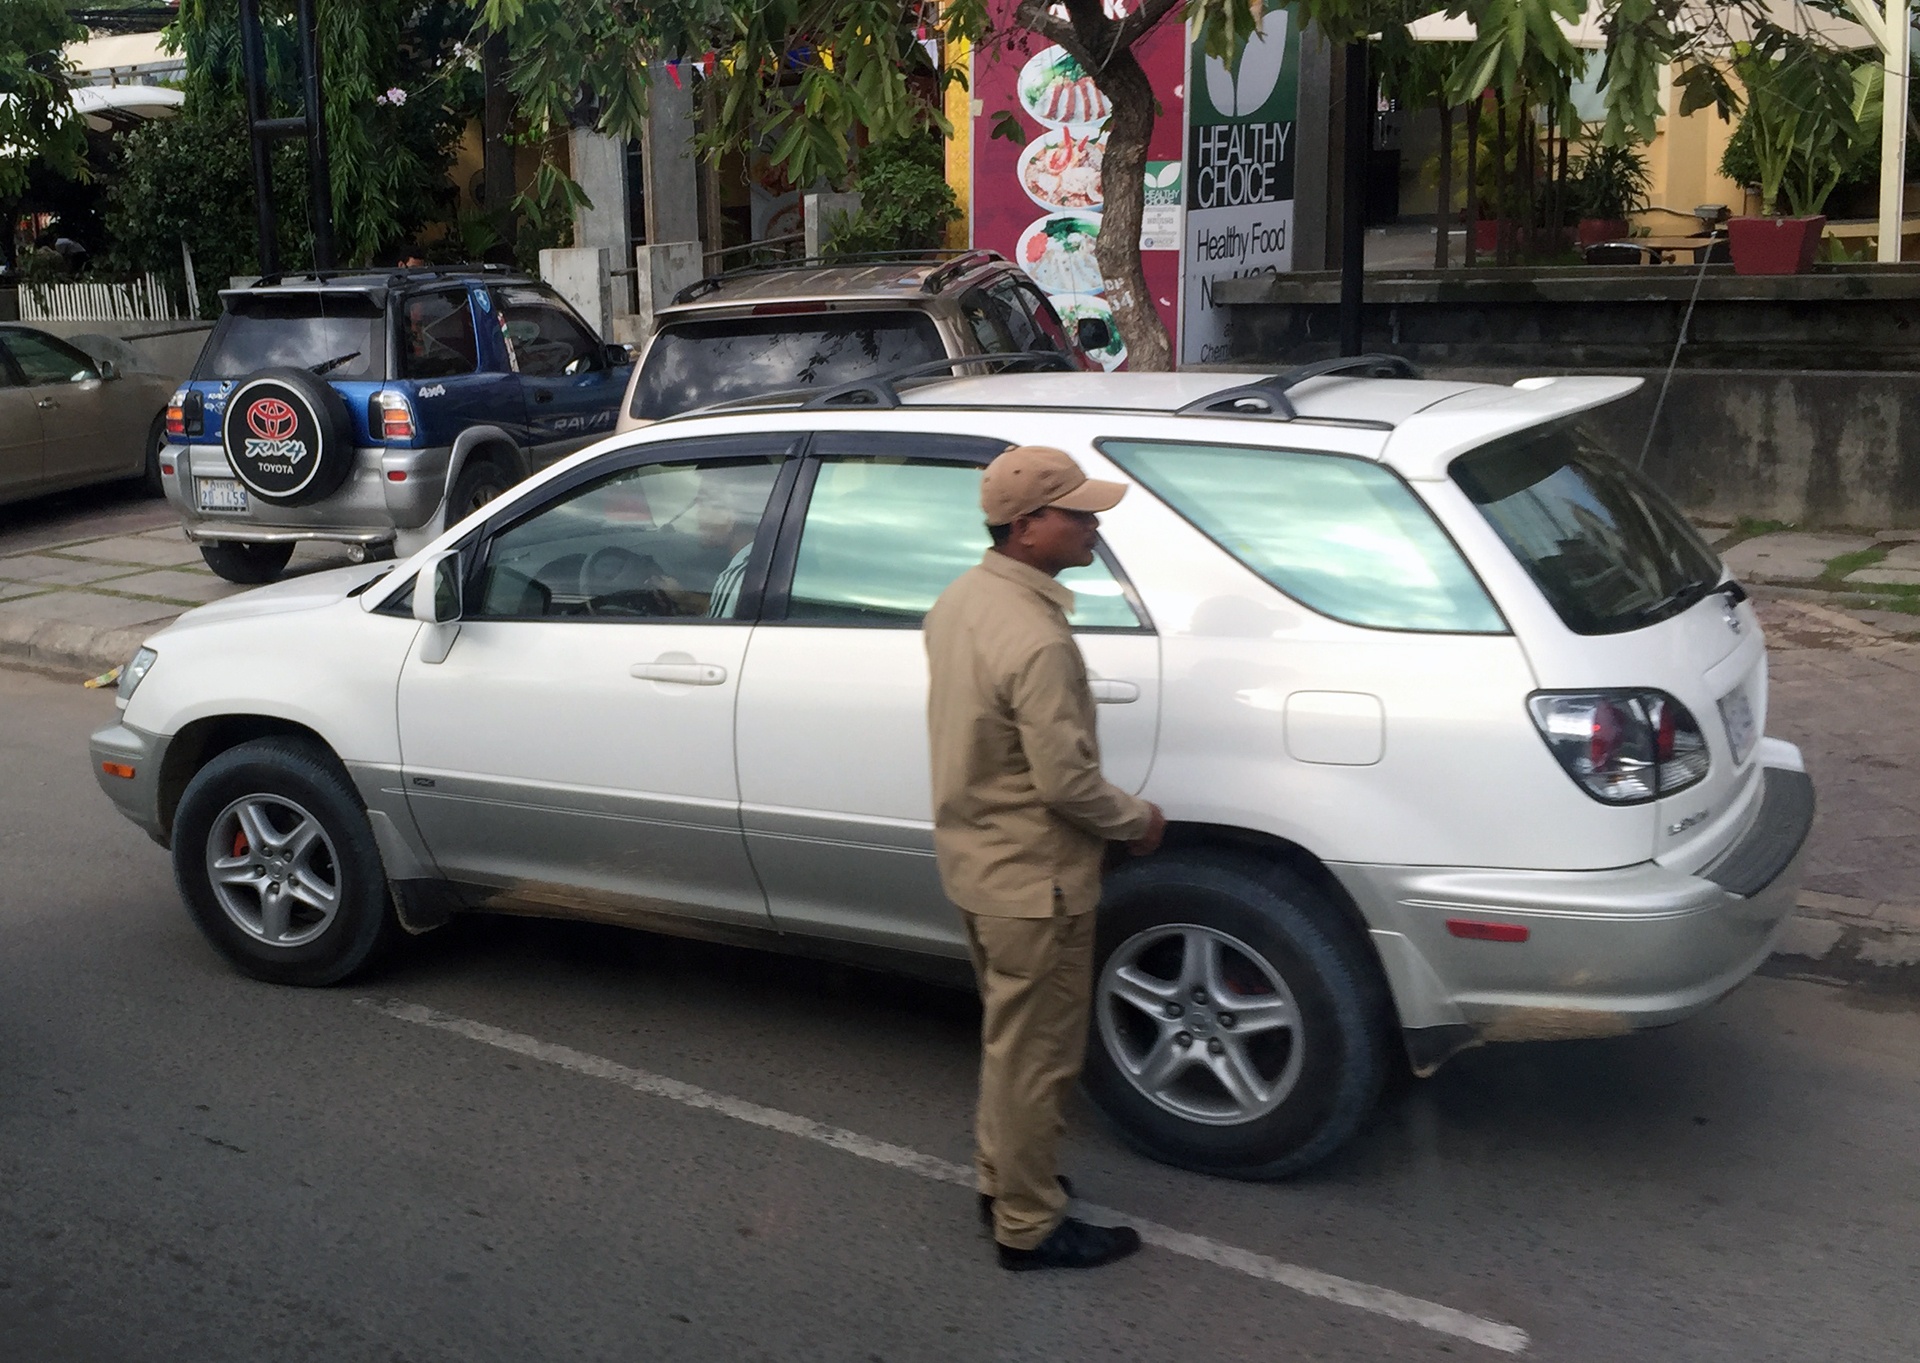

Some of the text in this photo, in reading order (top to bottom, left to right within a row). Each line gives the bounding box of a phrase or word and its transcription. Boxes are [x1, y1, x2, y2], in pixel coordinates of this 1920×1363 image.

[1198, 121, 1291, 168] HEALTHY
[1198, 161, 1276, 209] CHOICE
[1196, 219, 1286, 265] Healthy Food
[244, 438, 307, 464] RAV4
[258, 462, 294, 475] TOYOTA
